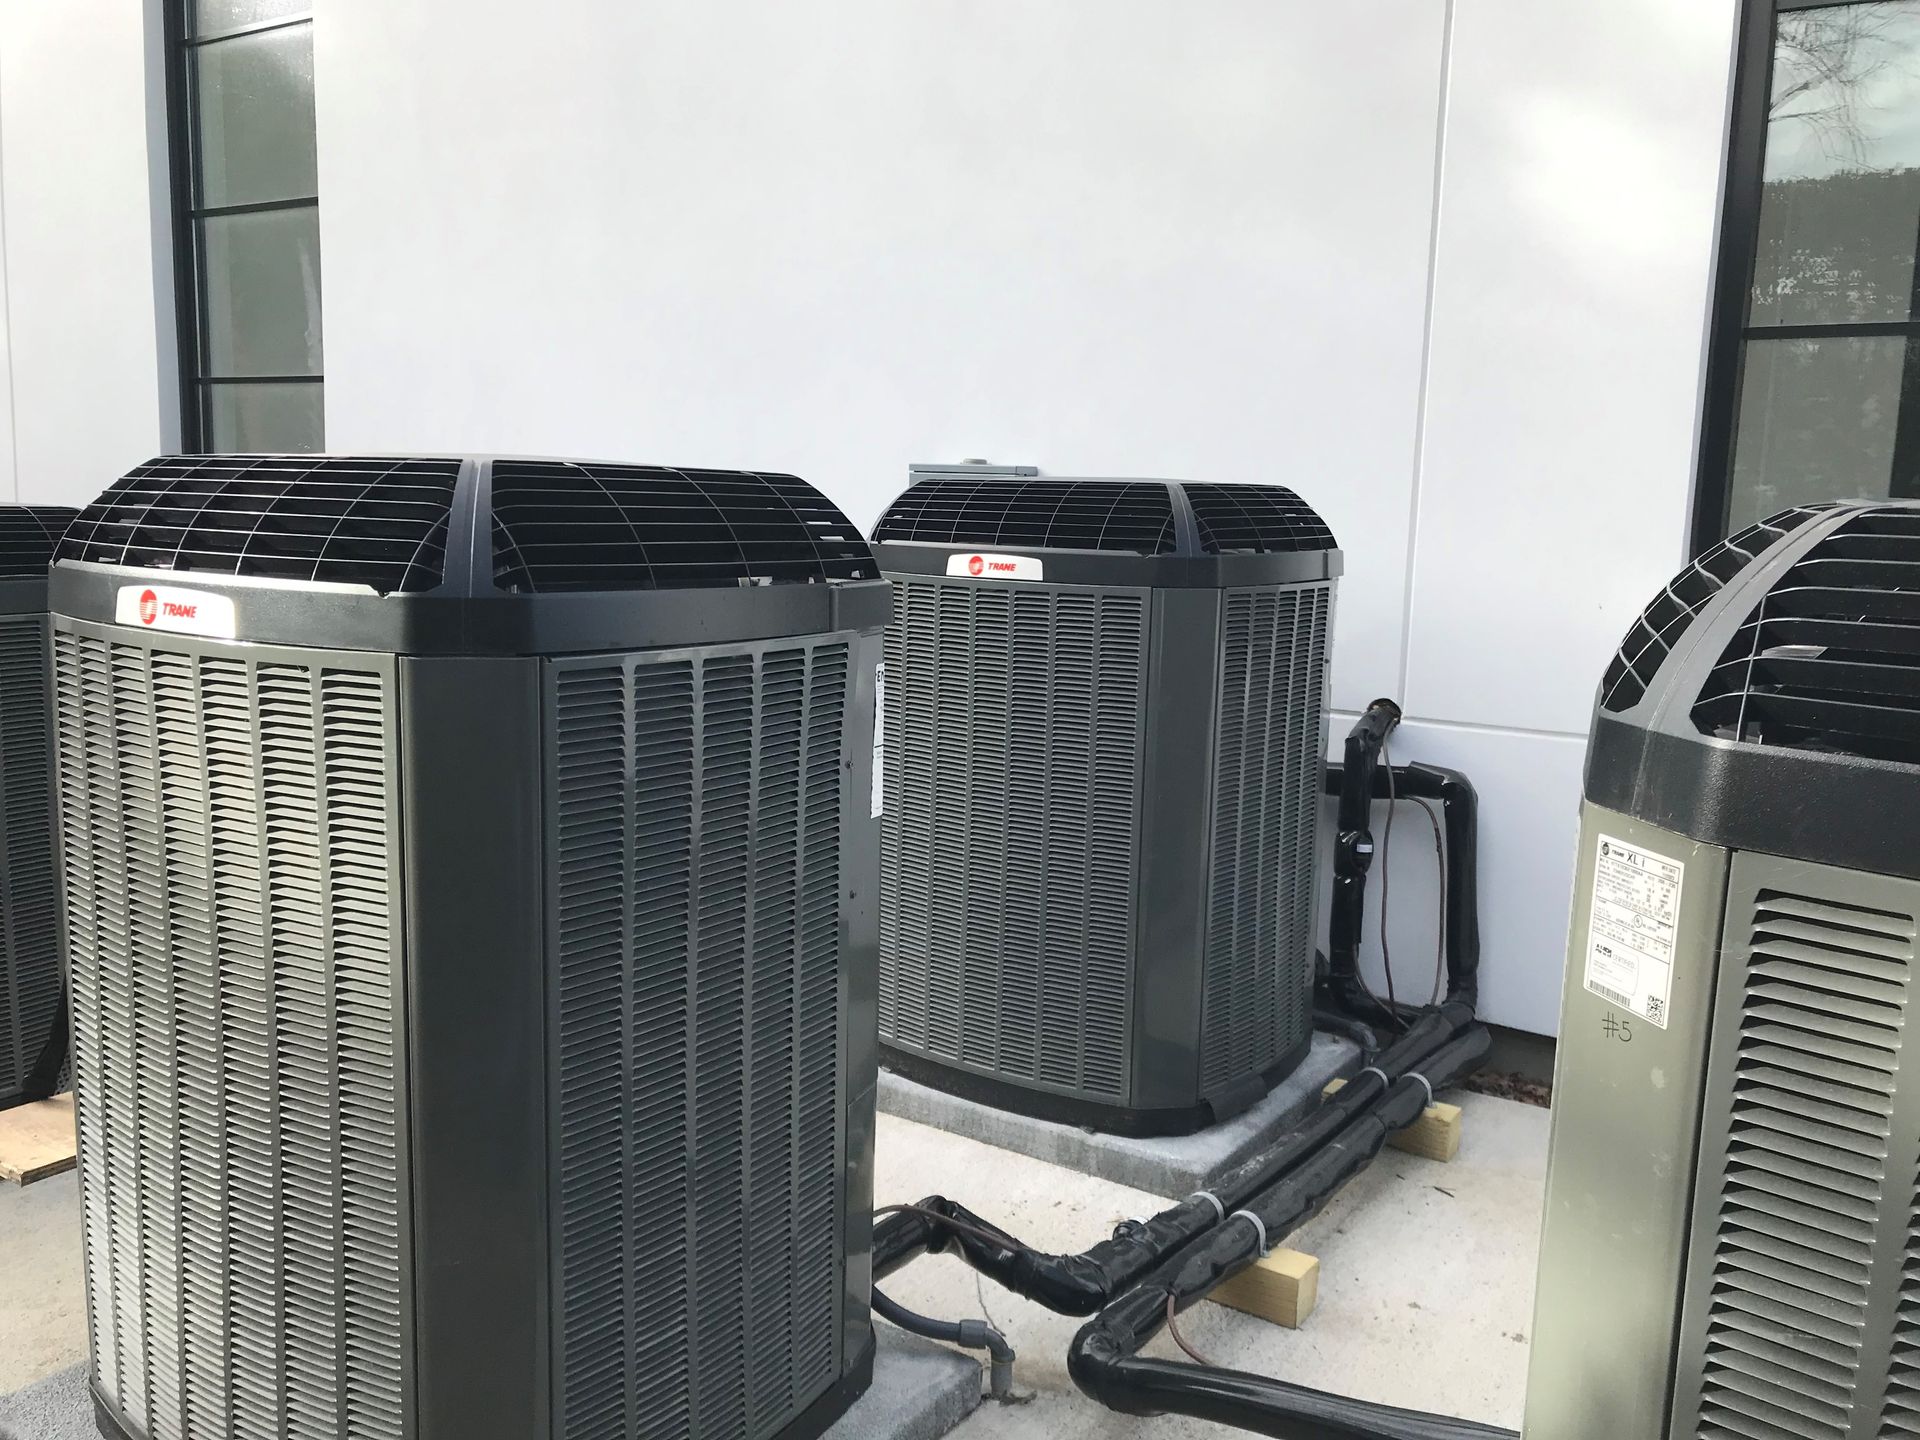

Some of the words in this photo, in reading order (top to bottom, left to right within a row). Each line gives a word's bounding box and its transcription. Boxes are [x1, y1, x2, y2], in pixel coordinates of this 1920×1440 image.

[988, 563, 1016, 571] TRANE
[163, 603, 197, 618] TRANE
[1602, 1011, 1632, 1042] #5
